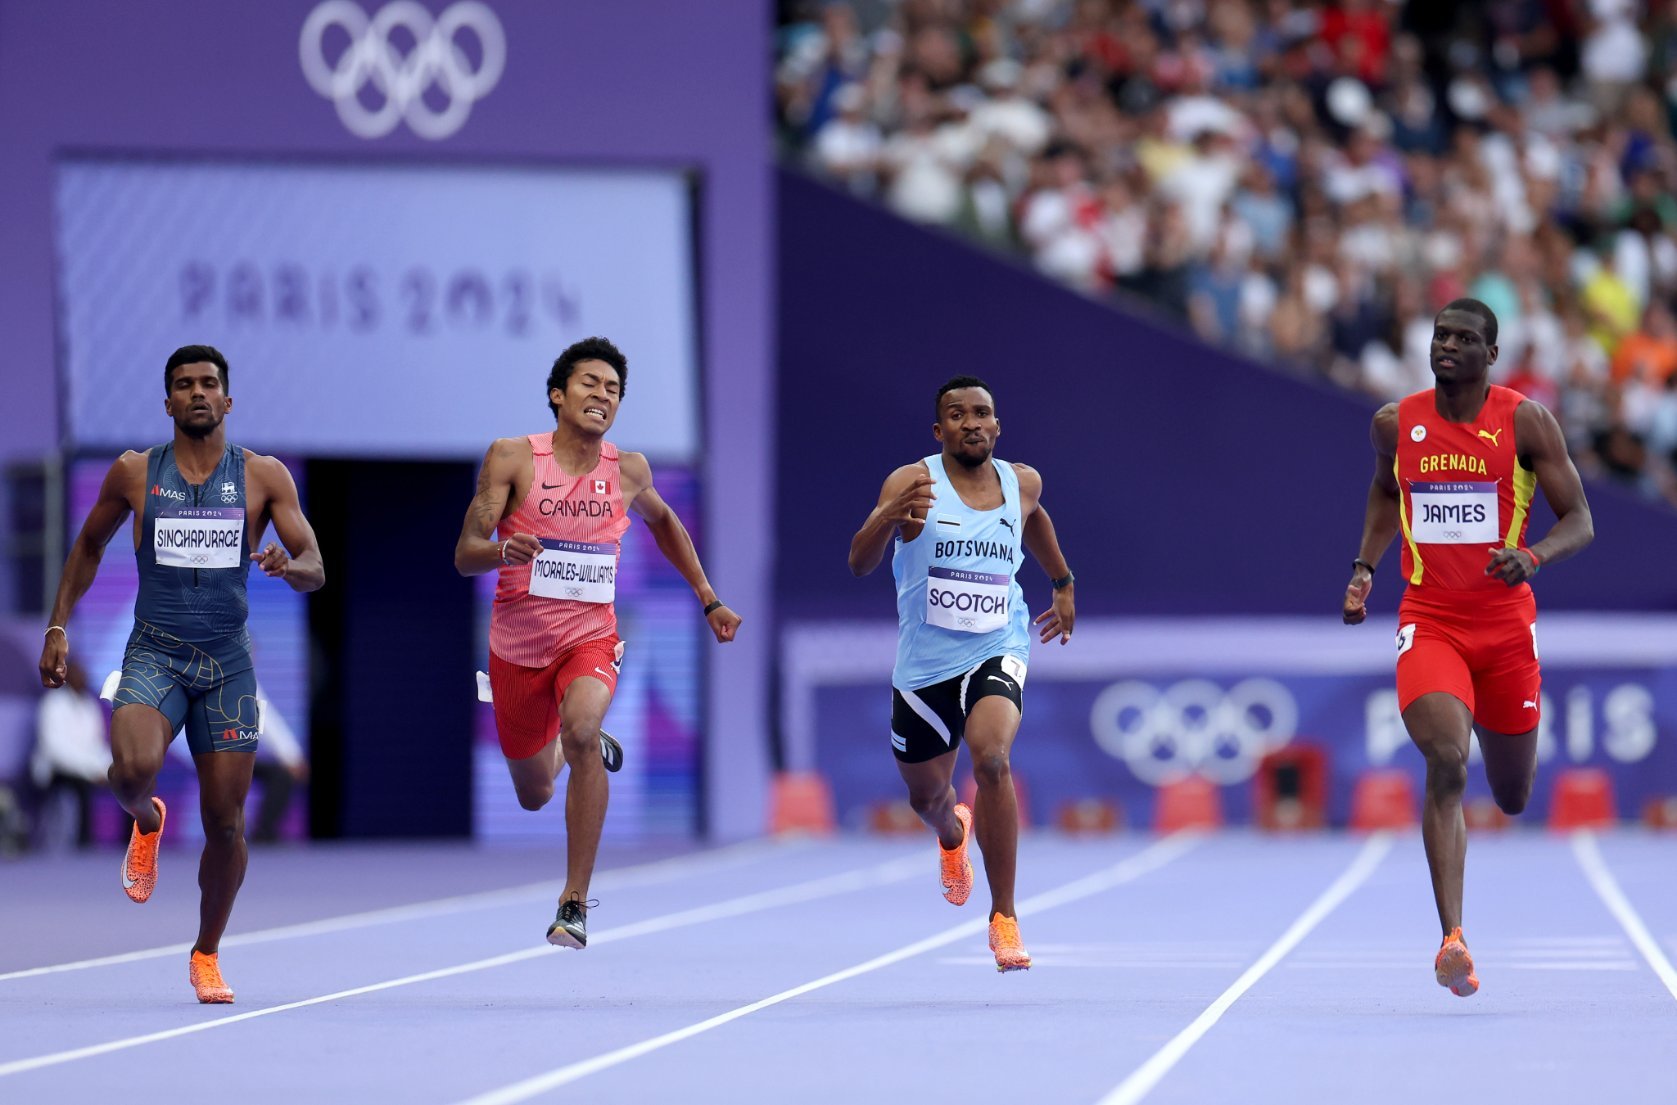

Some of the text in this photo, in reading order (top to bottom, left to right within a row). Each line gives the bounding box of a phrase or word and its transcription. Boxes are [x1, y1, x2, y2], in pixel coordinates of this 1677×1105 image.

[177, 260, 582, 338] PARIS 2024
[1420, 454, 1487, 475] GRENADA
[160, 488, 186, 501] MAS
[539, 498, 613, 518] CANADA
[1422, 504, 1486, 523] JAMES
[157, 529, 240, 548] SINGHAPURAGE
[558, 542, 581, 550] PARIS
[935, 540, 1014, 564] BOTSWANA
[534, 559, 614, 584] MORALES-WILLIAMS
[950, 571, 993, 582] PARIS 2024
[929, 588, 1005, 614] SCOTCH
[1010, 659, 1021, 677] 7
